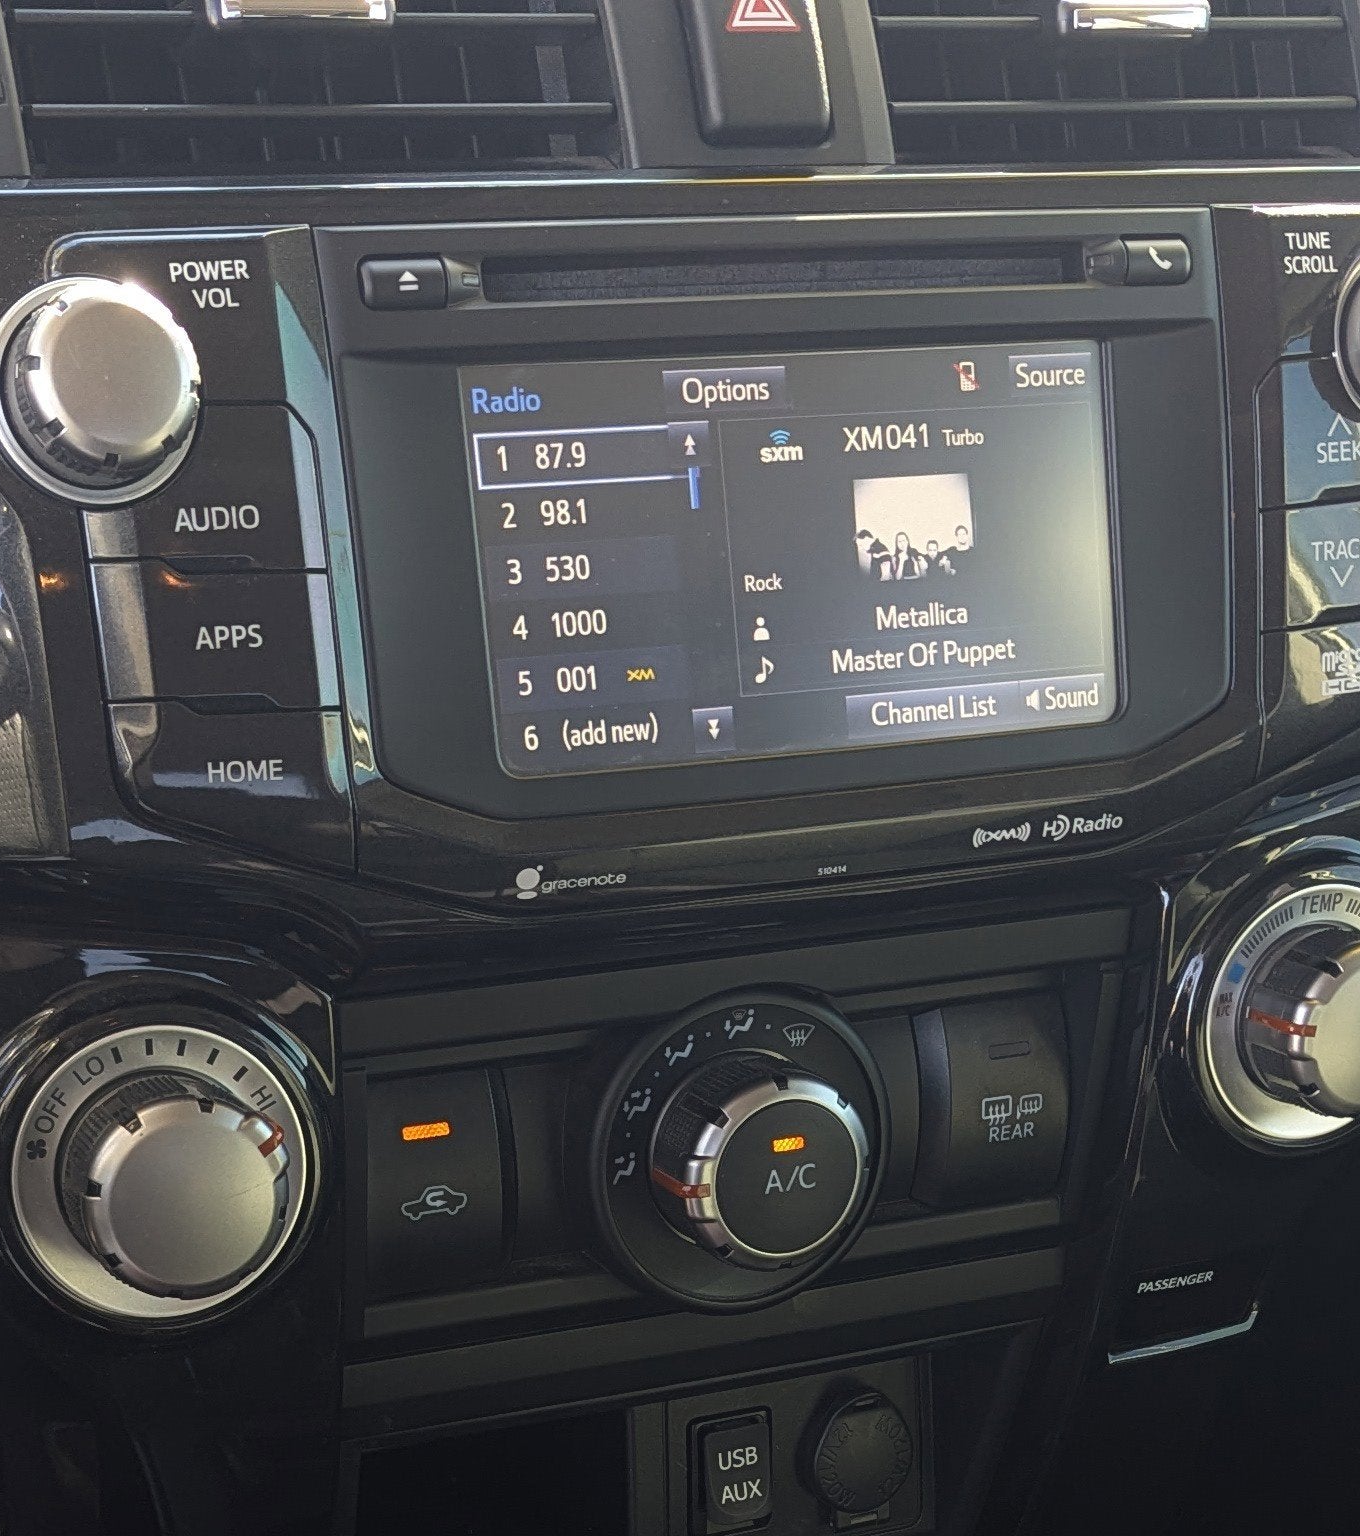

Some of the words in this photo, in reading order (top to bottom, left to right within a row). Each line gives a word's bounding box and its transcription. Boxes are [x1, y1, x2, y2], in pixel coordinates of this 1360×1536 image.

[1285, 231, 1331, 250] TUNE
[169, 259, 249, 284] POWER
[1284, 255, 1338, 275] SCROLL
[192, 287, 240, 309] VOL
[1016, 363, 1086, 389] Source
[472, 386, 541, 414] Radio
[682, 377, 769, 408] Options
[942, 428, 984, 448] Turbo
[497, 445, 508, 472] 1
[535, 442, 586, 469] 87.9
[760, 444, 803, 463] sxm
[174, 505, 260, 533] AUDIO
[501, 502, 517, 529] 2
[541, 498, 587, 526] 98.1
[507, 558, 522, 585] 3
[545, 554, 590, 582] 530
[744, 572, 782, 593] Rock
[512, 614, 528, 640] 4
[551, 609, 607, 637] 1000
[876, 602, 968, 631] Metallica
[195, 624, 263, 650] APPS
[832, 647, 904, 675] Master
[909, 642, 937, 667] Of
[944, 639, 1016, 668] Puppet
[518, 670, 533, 696] 5
[557, 665, 597, 692] 001
[872, 696, 954, 727] Channel
[960, 694, 997, 719] List
[1045, 684, 1099, 711] Sound
[524, 725, 539, 751] 6
[562, 723, 606, 752] (add
[611, 712, 658, 744] new)
[207, 760, 283, 783] HOME
[1072, 813, 1123, 834] Radio
[541, 873, 627, 894] gracenote
[1301, 893, 1343, 915] TEMP
[72, 1057, 105, 1085] LO
[35, 1087, 67, 1134] OFF
[250, 1085, 277, 1112] HI
[988, 1121, 1035, 1143] REAR
[765, 1162, 817, 1194] A/C
[1137, 1271, 1213, 1293] PASSENGER
[718, 1446, 758, 1471] USB
[721, 1479, 763, 1504] AUX
